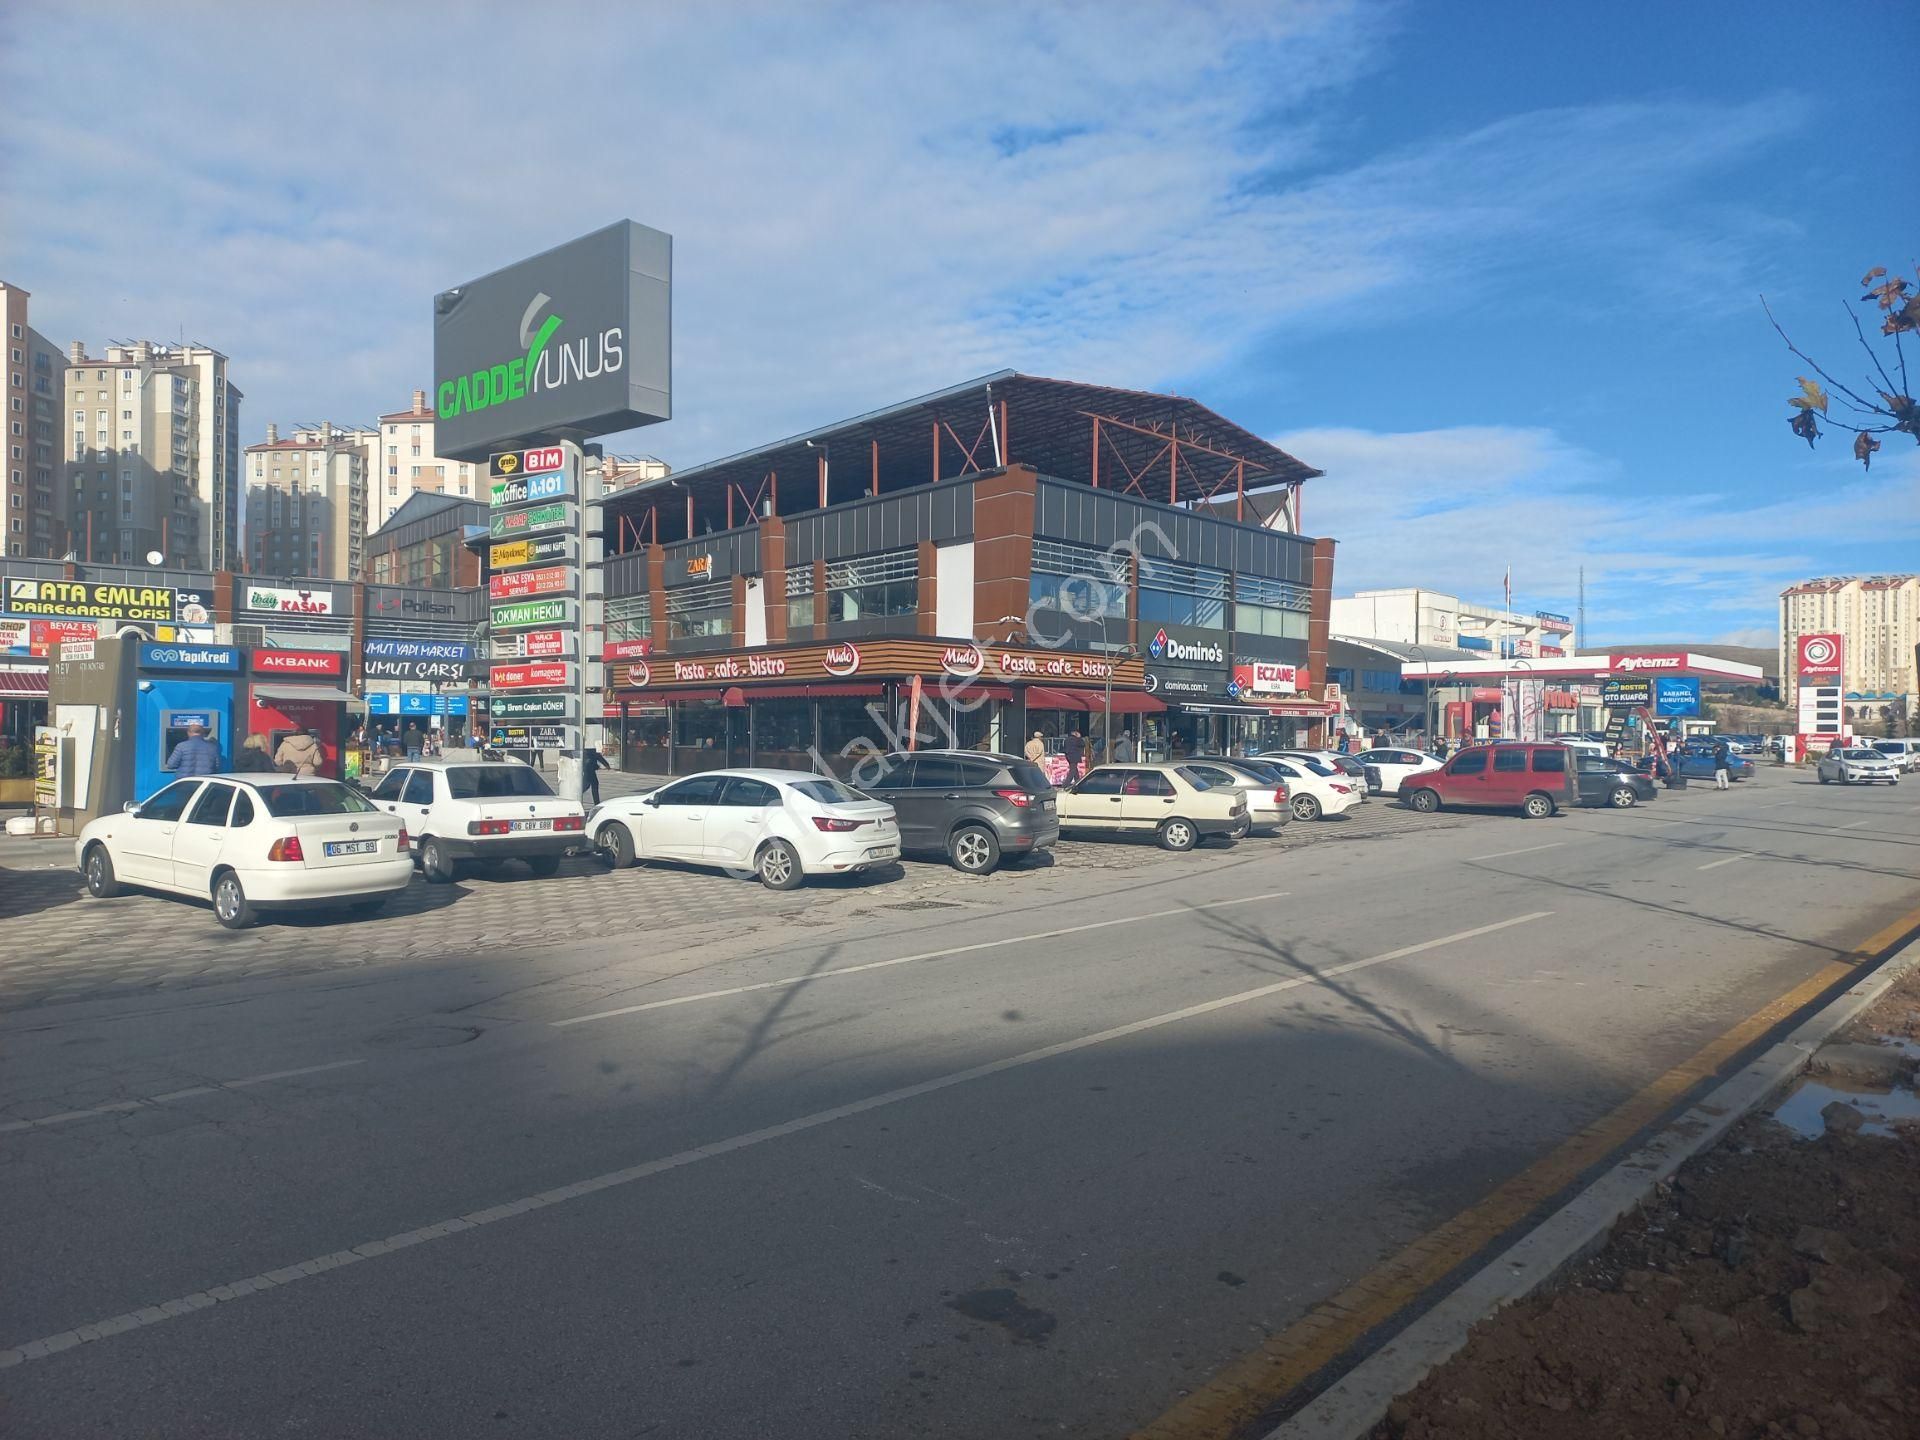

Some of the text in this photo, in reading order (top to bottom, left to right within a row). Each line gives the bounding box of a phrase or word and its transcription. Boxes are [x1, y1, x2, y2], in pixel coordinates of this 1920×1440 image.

[502, 575, 519, 586] BEYAZ
[40, 582, 170, 608] ATA EMLAK
[281, 600, 327, 613] KASAP
[401, 599, 456, 614] Polisan
[491, 601, 562, 624] LOKMAN HEKİM
[50, 622, 78, 630] BEYAZ
[364, 642, 393, 655] UMUT
[397, 644, 418, 655] YAPI
[420, 645, 464, 658] MARKET
[825, 647, 853, 665] Mudo
[943, 648, 977, 665] Mudo
[1167, 640, 1223, 663] Domino's
[263, 656, 330, 669] AKBANK
[365, 661, 463, 679] UMUT ÇARŞI
[675, 656, 785, 679] Pasta cafe bistro
[1002, 653, 1112, 677] Pasta cafe bistro
[628, 664, 646, 677] Mudo
[1257, 666, 1294, 682] ECZANE
[1164, 680, 1208, 692] dominos.com.tr
[1620, 692, 1648, 701] KUAFÖR
[539, 727, 557, 736] ZARA
[513, 821, 522, 831] 06
[332, 843, 341, 854] 06
[346, 843, 360, 853] MST
